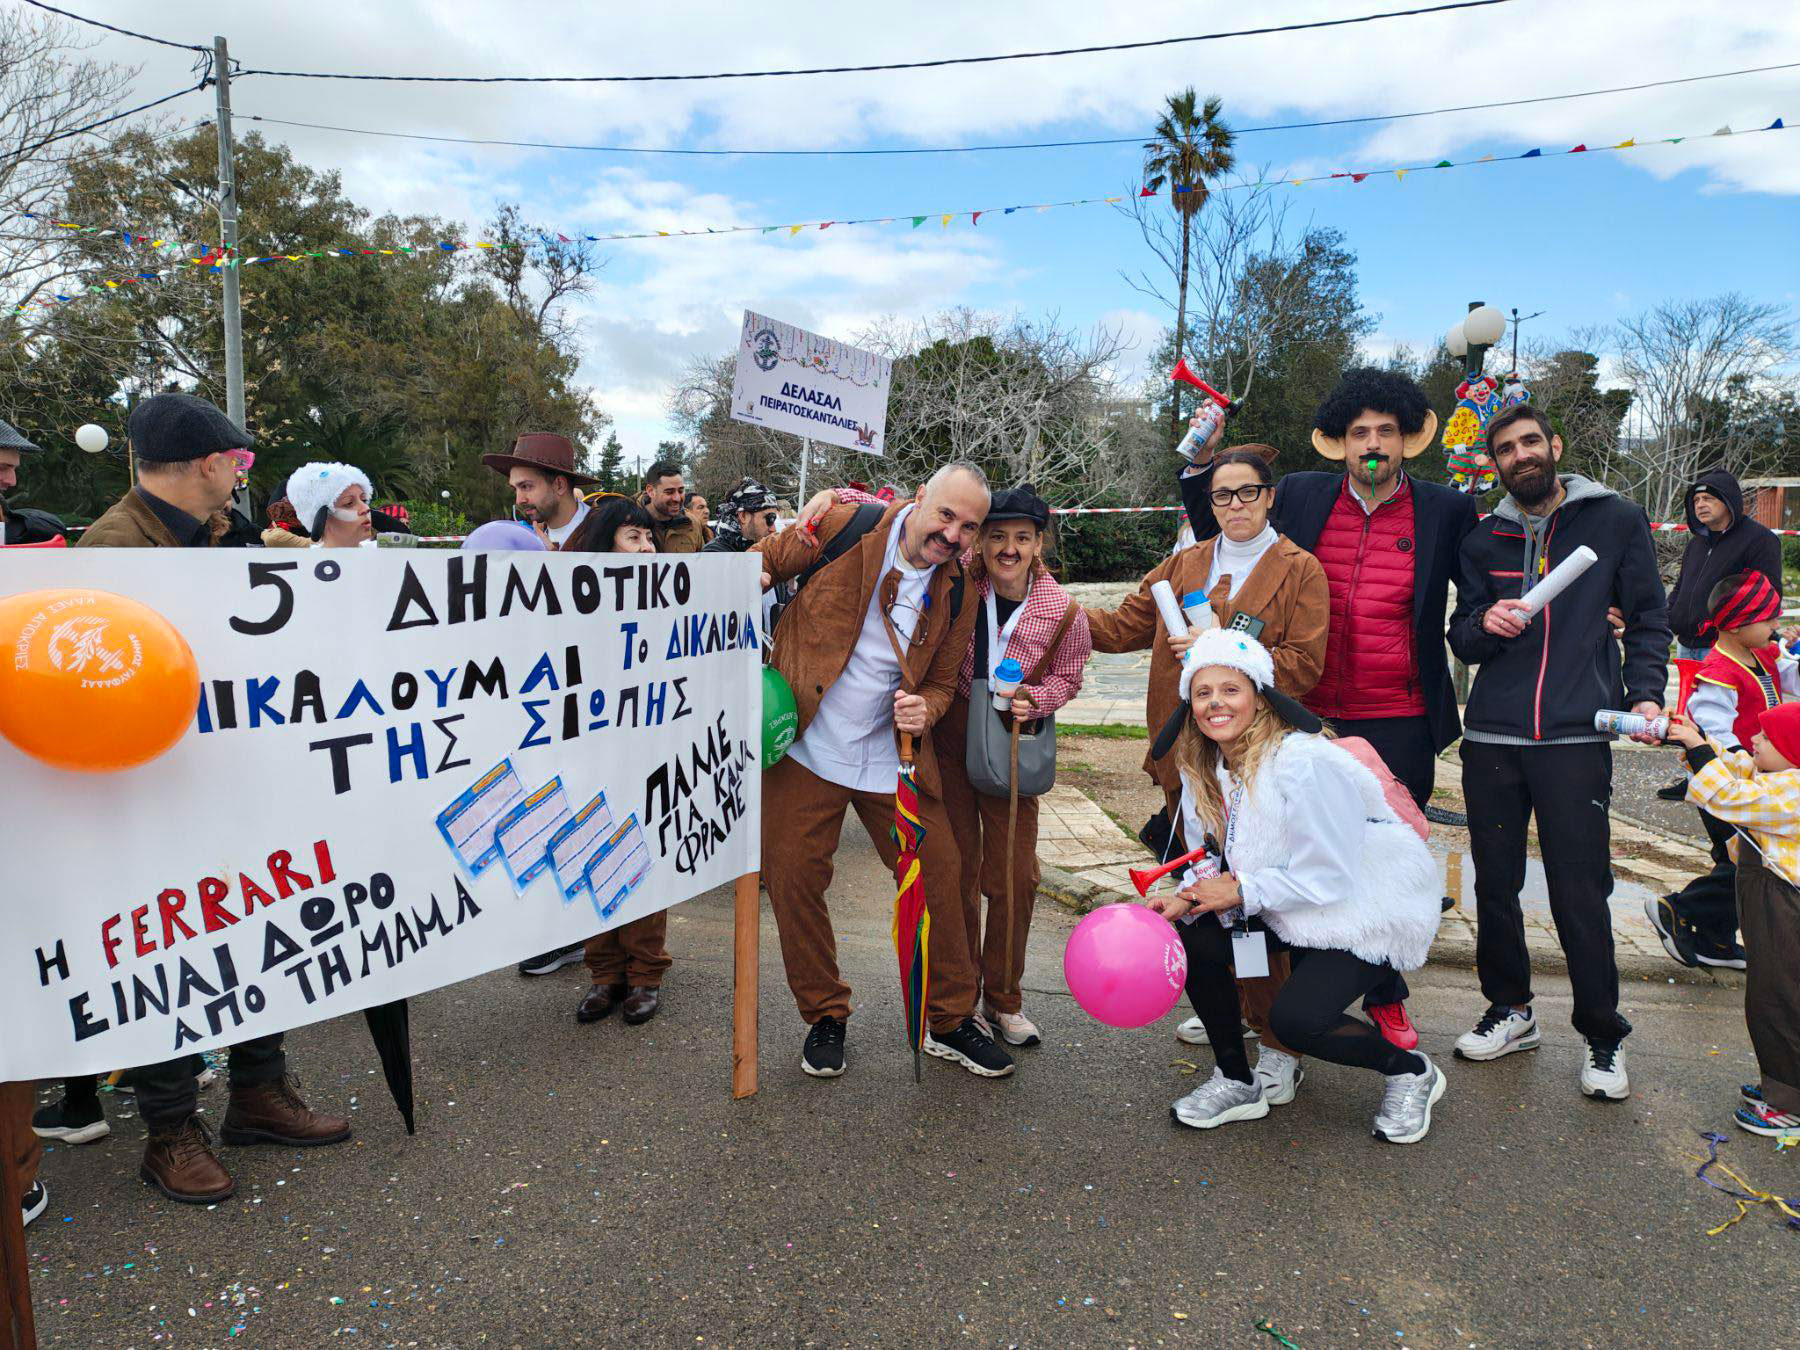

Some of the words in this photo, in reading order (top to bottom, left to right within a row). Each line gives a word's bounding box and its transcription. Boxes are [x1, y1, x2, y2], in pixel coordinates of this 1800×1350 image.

[760, 395, 858, 432] ΠΕΙΡΑΤΟΣΚΑΝΤΑΛΙΕΣ
[780, 382, 842, 411] ΔΕΛΑΣΑΛ
[386, 554, 690, 631] ΔΗΜΟΤΙΚΟ
[665, 610, 759, 661] ΔΙΚΑΙΩΜΑ
[309, 713, 471, 796] ΤΗΣ
[518, 677, 693, 750] ΣΙΩΠΗΣ
[645, 709, 732, 826] ΠΑΜΕ
[658, 798, 704, 858] ΓΙΑ
[713, 739, 756, 807] ΚΑΝΑ
[675, 780, 746, 877] ΦΡΑΠΕ
[35, 938, 70, 987] Η
[101, 839, 337, 969] FERRARI
[69, 942, 239, 1042] ΕΙΝΑΙ
[260, 872, 396, 973] ΔΩΡΟ
[174, 984, 266, 1051] ΑΠΟ
[284, 944, 353, 1005] ΤΗ
[359, 873, 483, 978] ΜΑΜΑ
